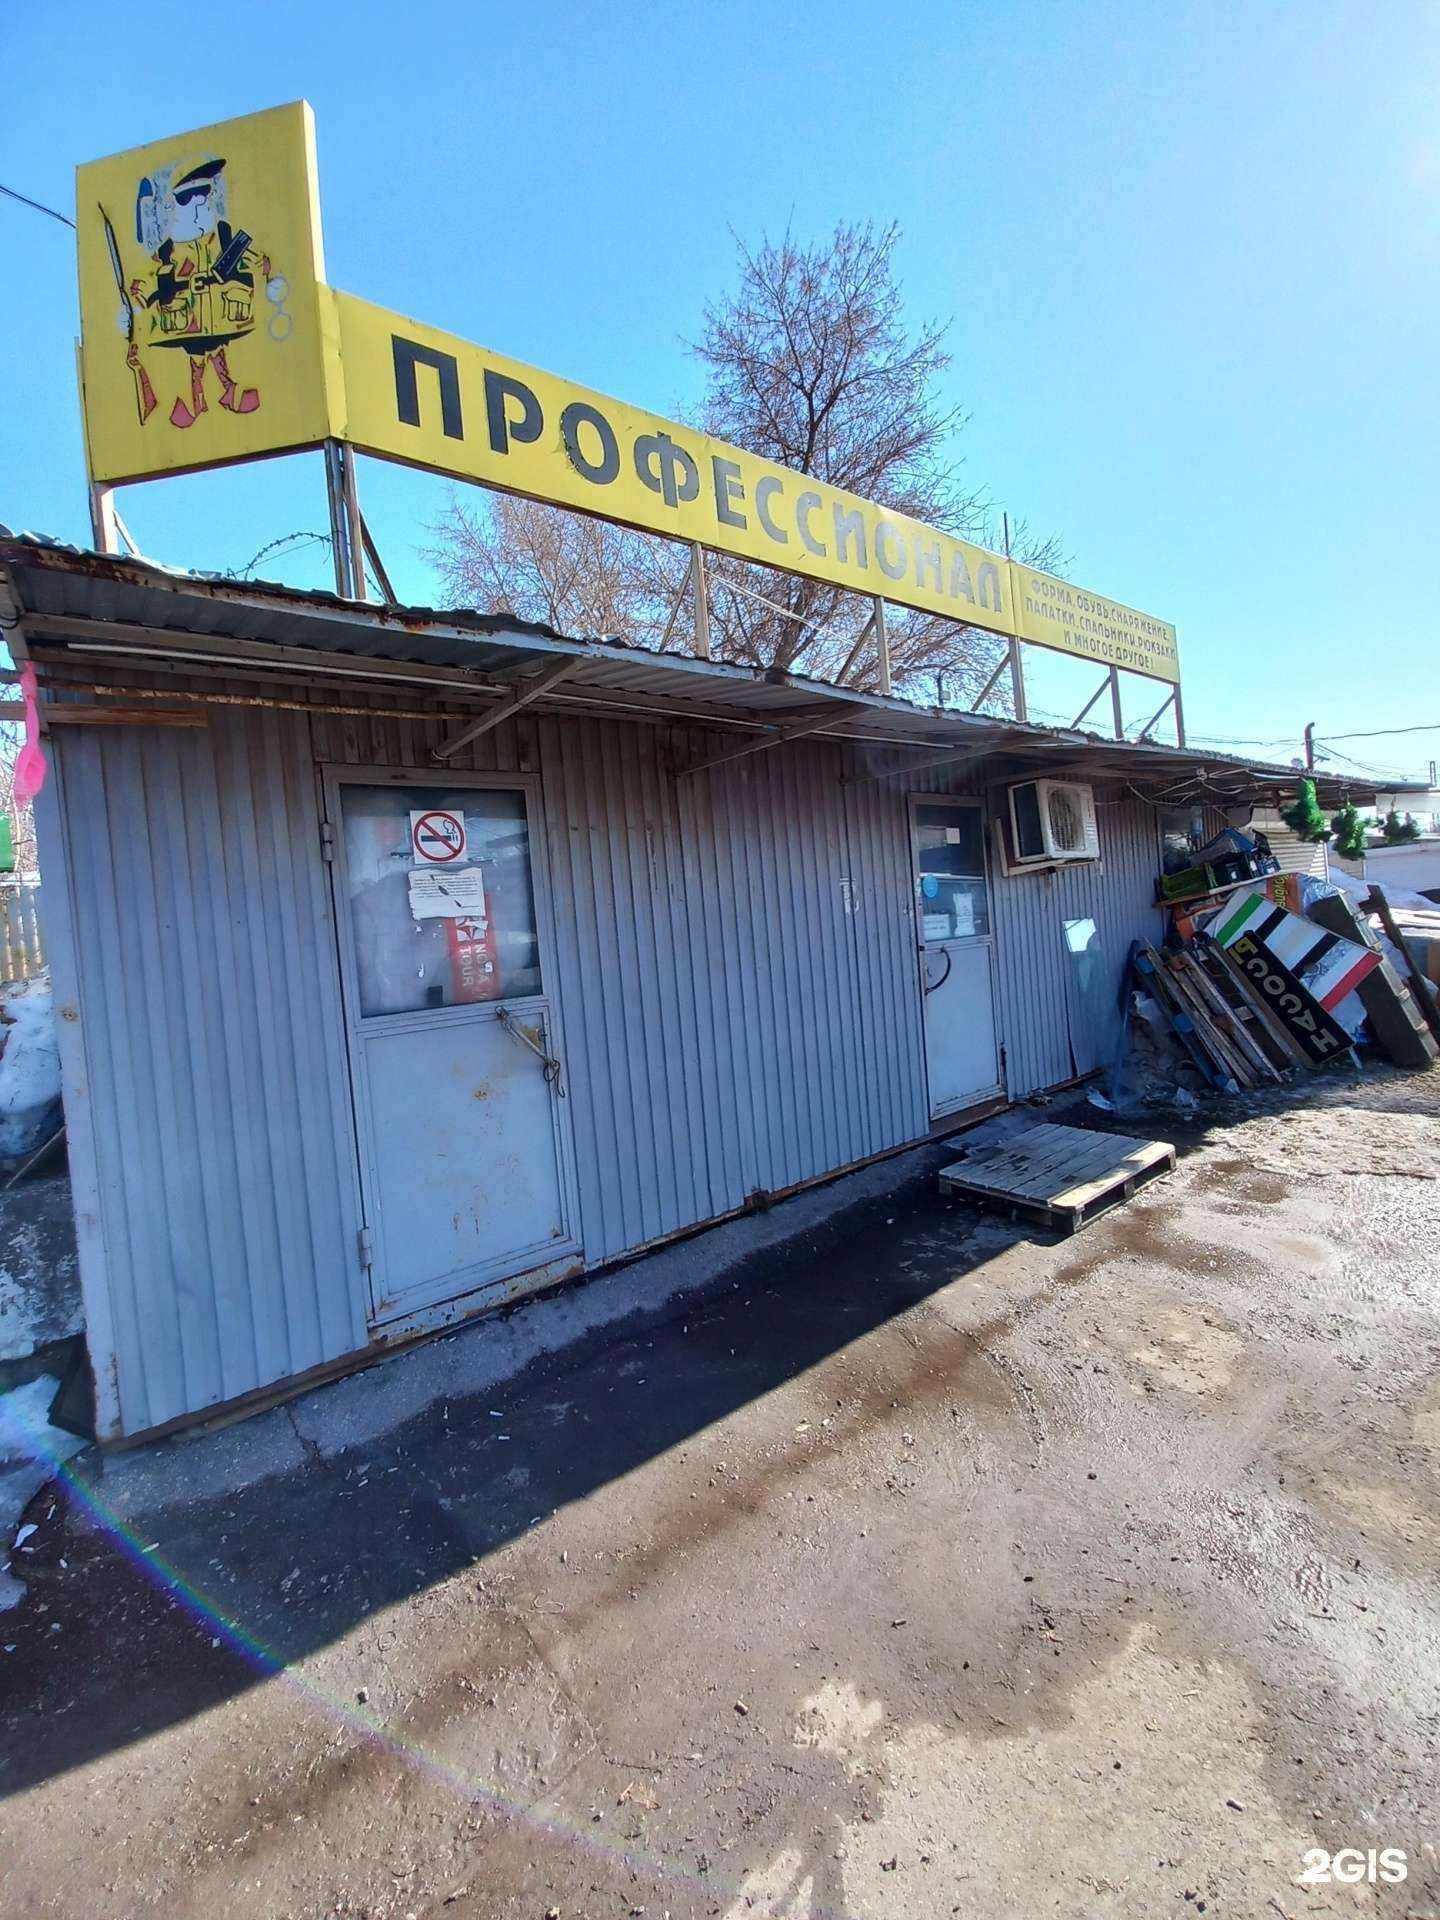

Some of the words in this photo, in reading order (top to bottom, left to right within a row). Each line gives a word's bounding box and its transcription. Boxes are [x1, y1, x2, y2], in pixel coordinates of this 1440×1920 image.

[391, 333, 1002, 612] ПРОФЕССИОНАЛ
[1074, 632, 1114, 658] МНОГОЕ
[1229, 936, 1340, 1053] НАСОСЫ
